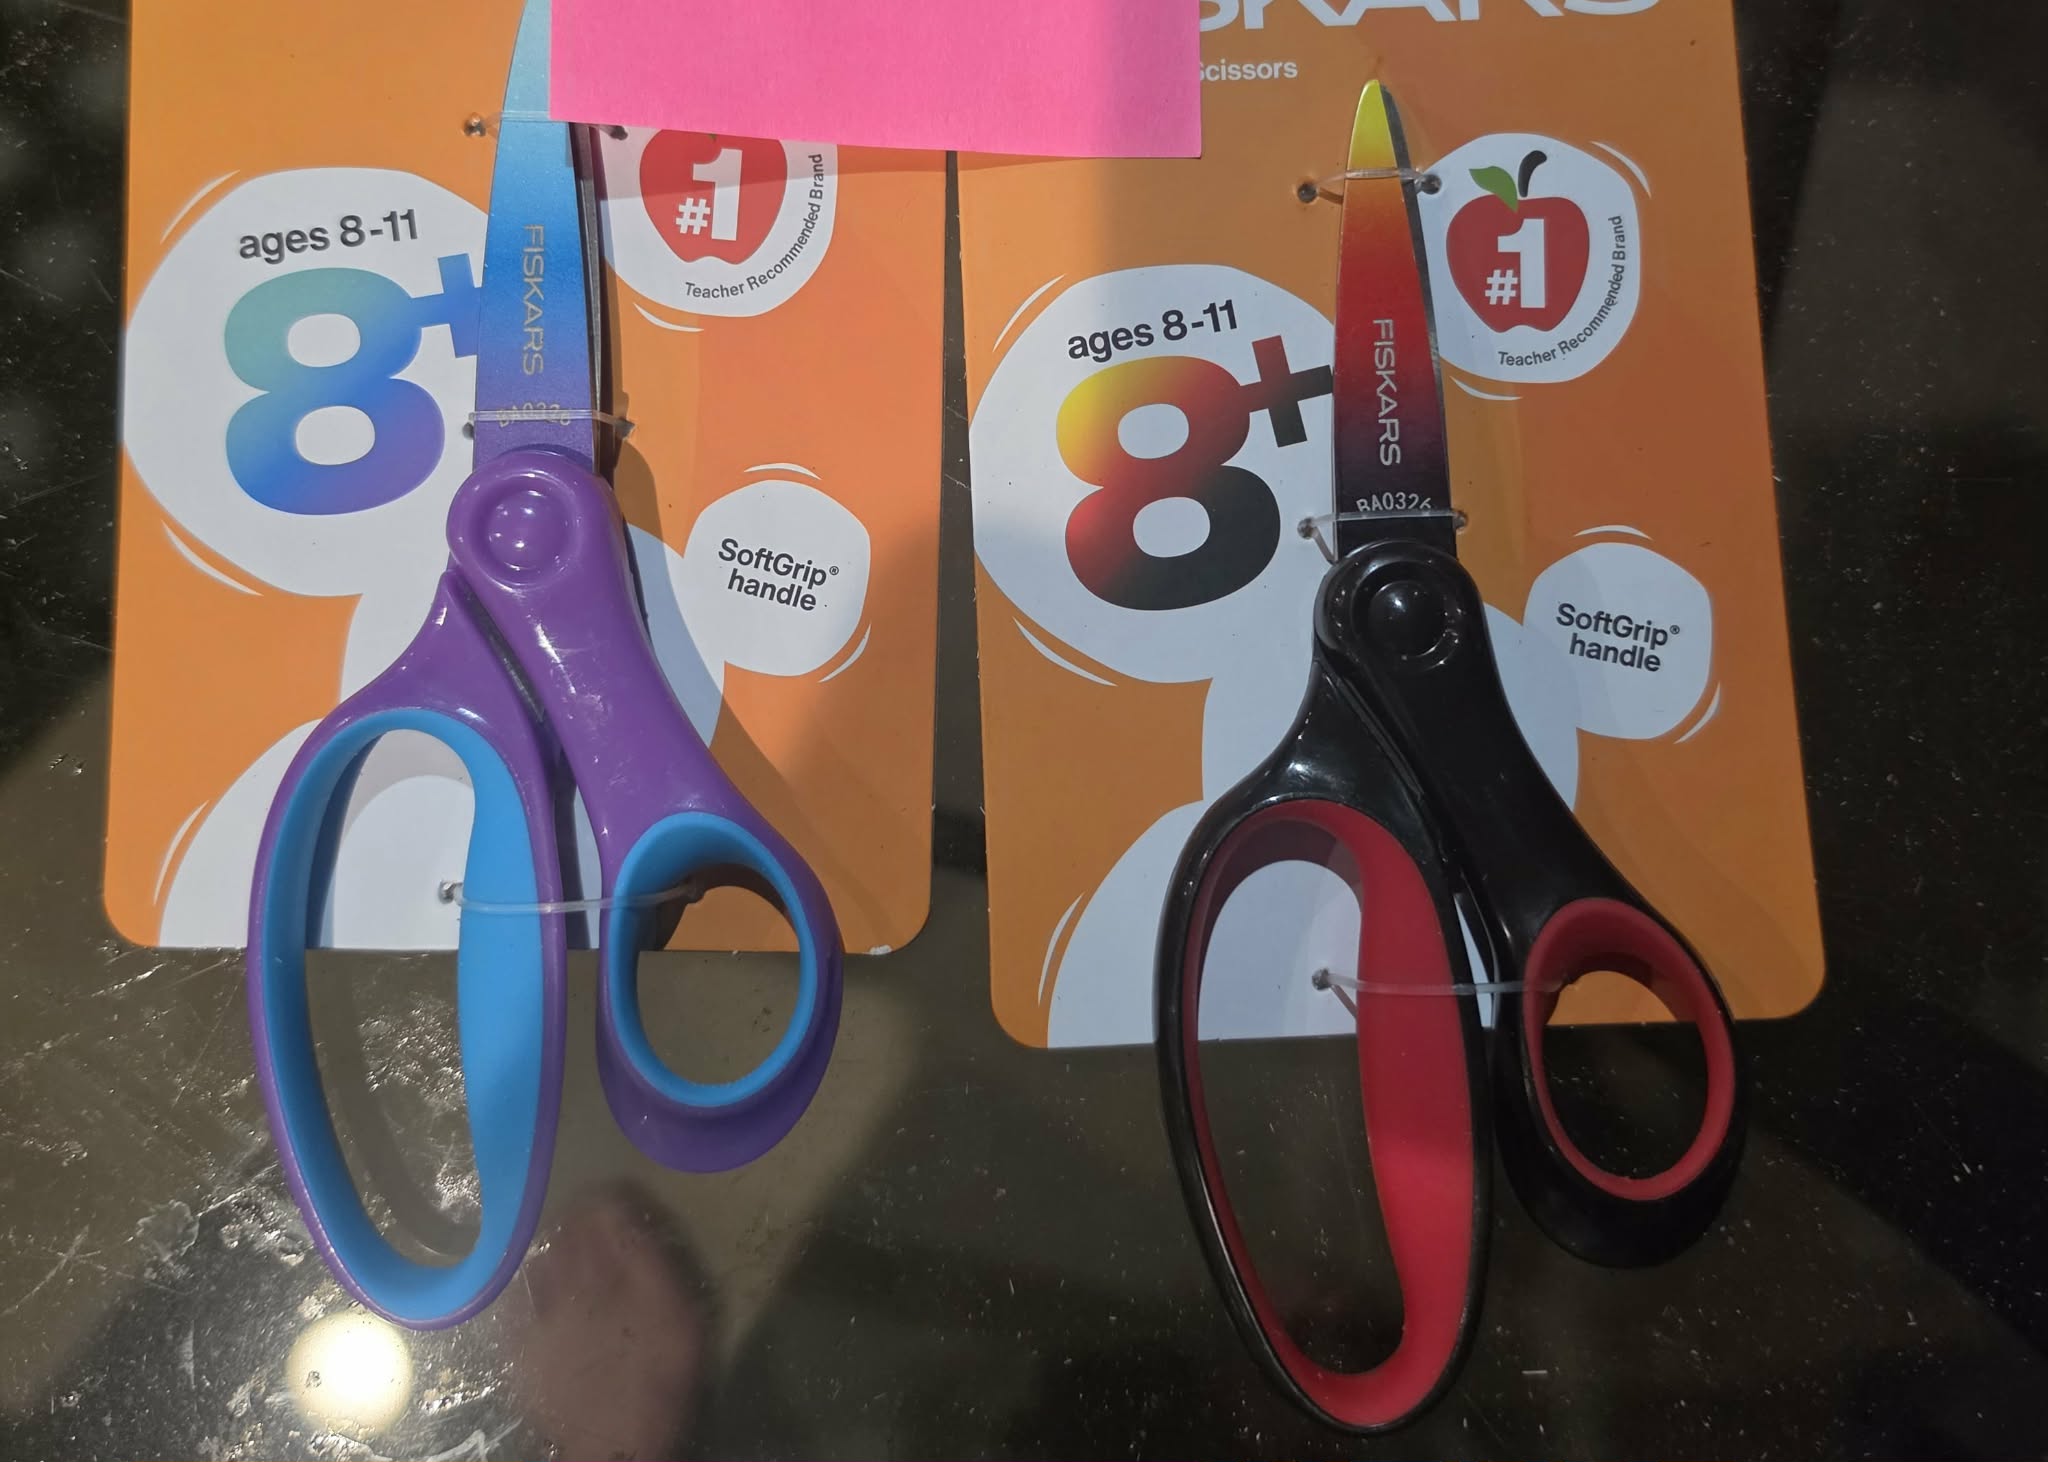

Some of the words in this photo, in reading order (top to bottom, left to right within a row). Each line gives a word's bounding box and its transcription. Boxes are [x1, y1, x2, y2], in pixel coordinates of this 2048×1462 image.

[239, 226, 331, 265] ages
[339, 208, 418, 248] 8-11
[685, 281, 745, 299] Teacher
[746, 202, 822, 291] Recommended
[808, 153, 824, 200] Brand
[1497, 349, 1557, 367] Teacher
[1557, 263, 1626, 356] Recommended
[1607, 214, 1627, 261] Brand
[522, 223, 545, 376] FISKARS
[1067, 323, 1155, 363] ages
[1161, 299, 1238, 341] 8-11
[1372, 318, 1402, 467] FISKARS
[1055, 334, 1334, 612] 8+
[727, 567, 817, 611] handle
[1568, 632, 1662, 673] handle
